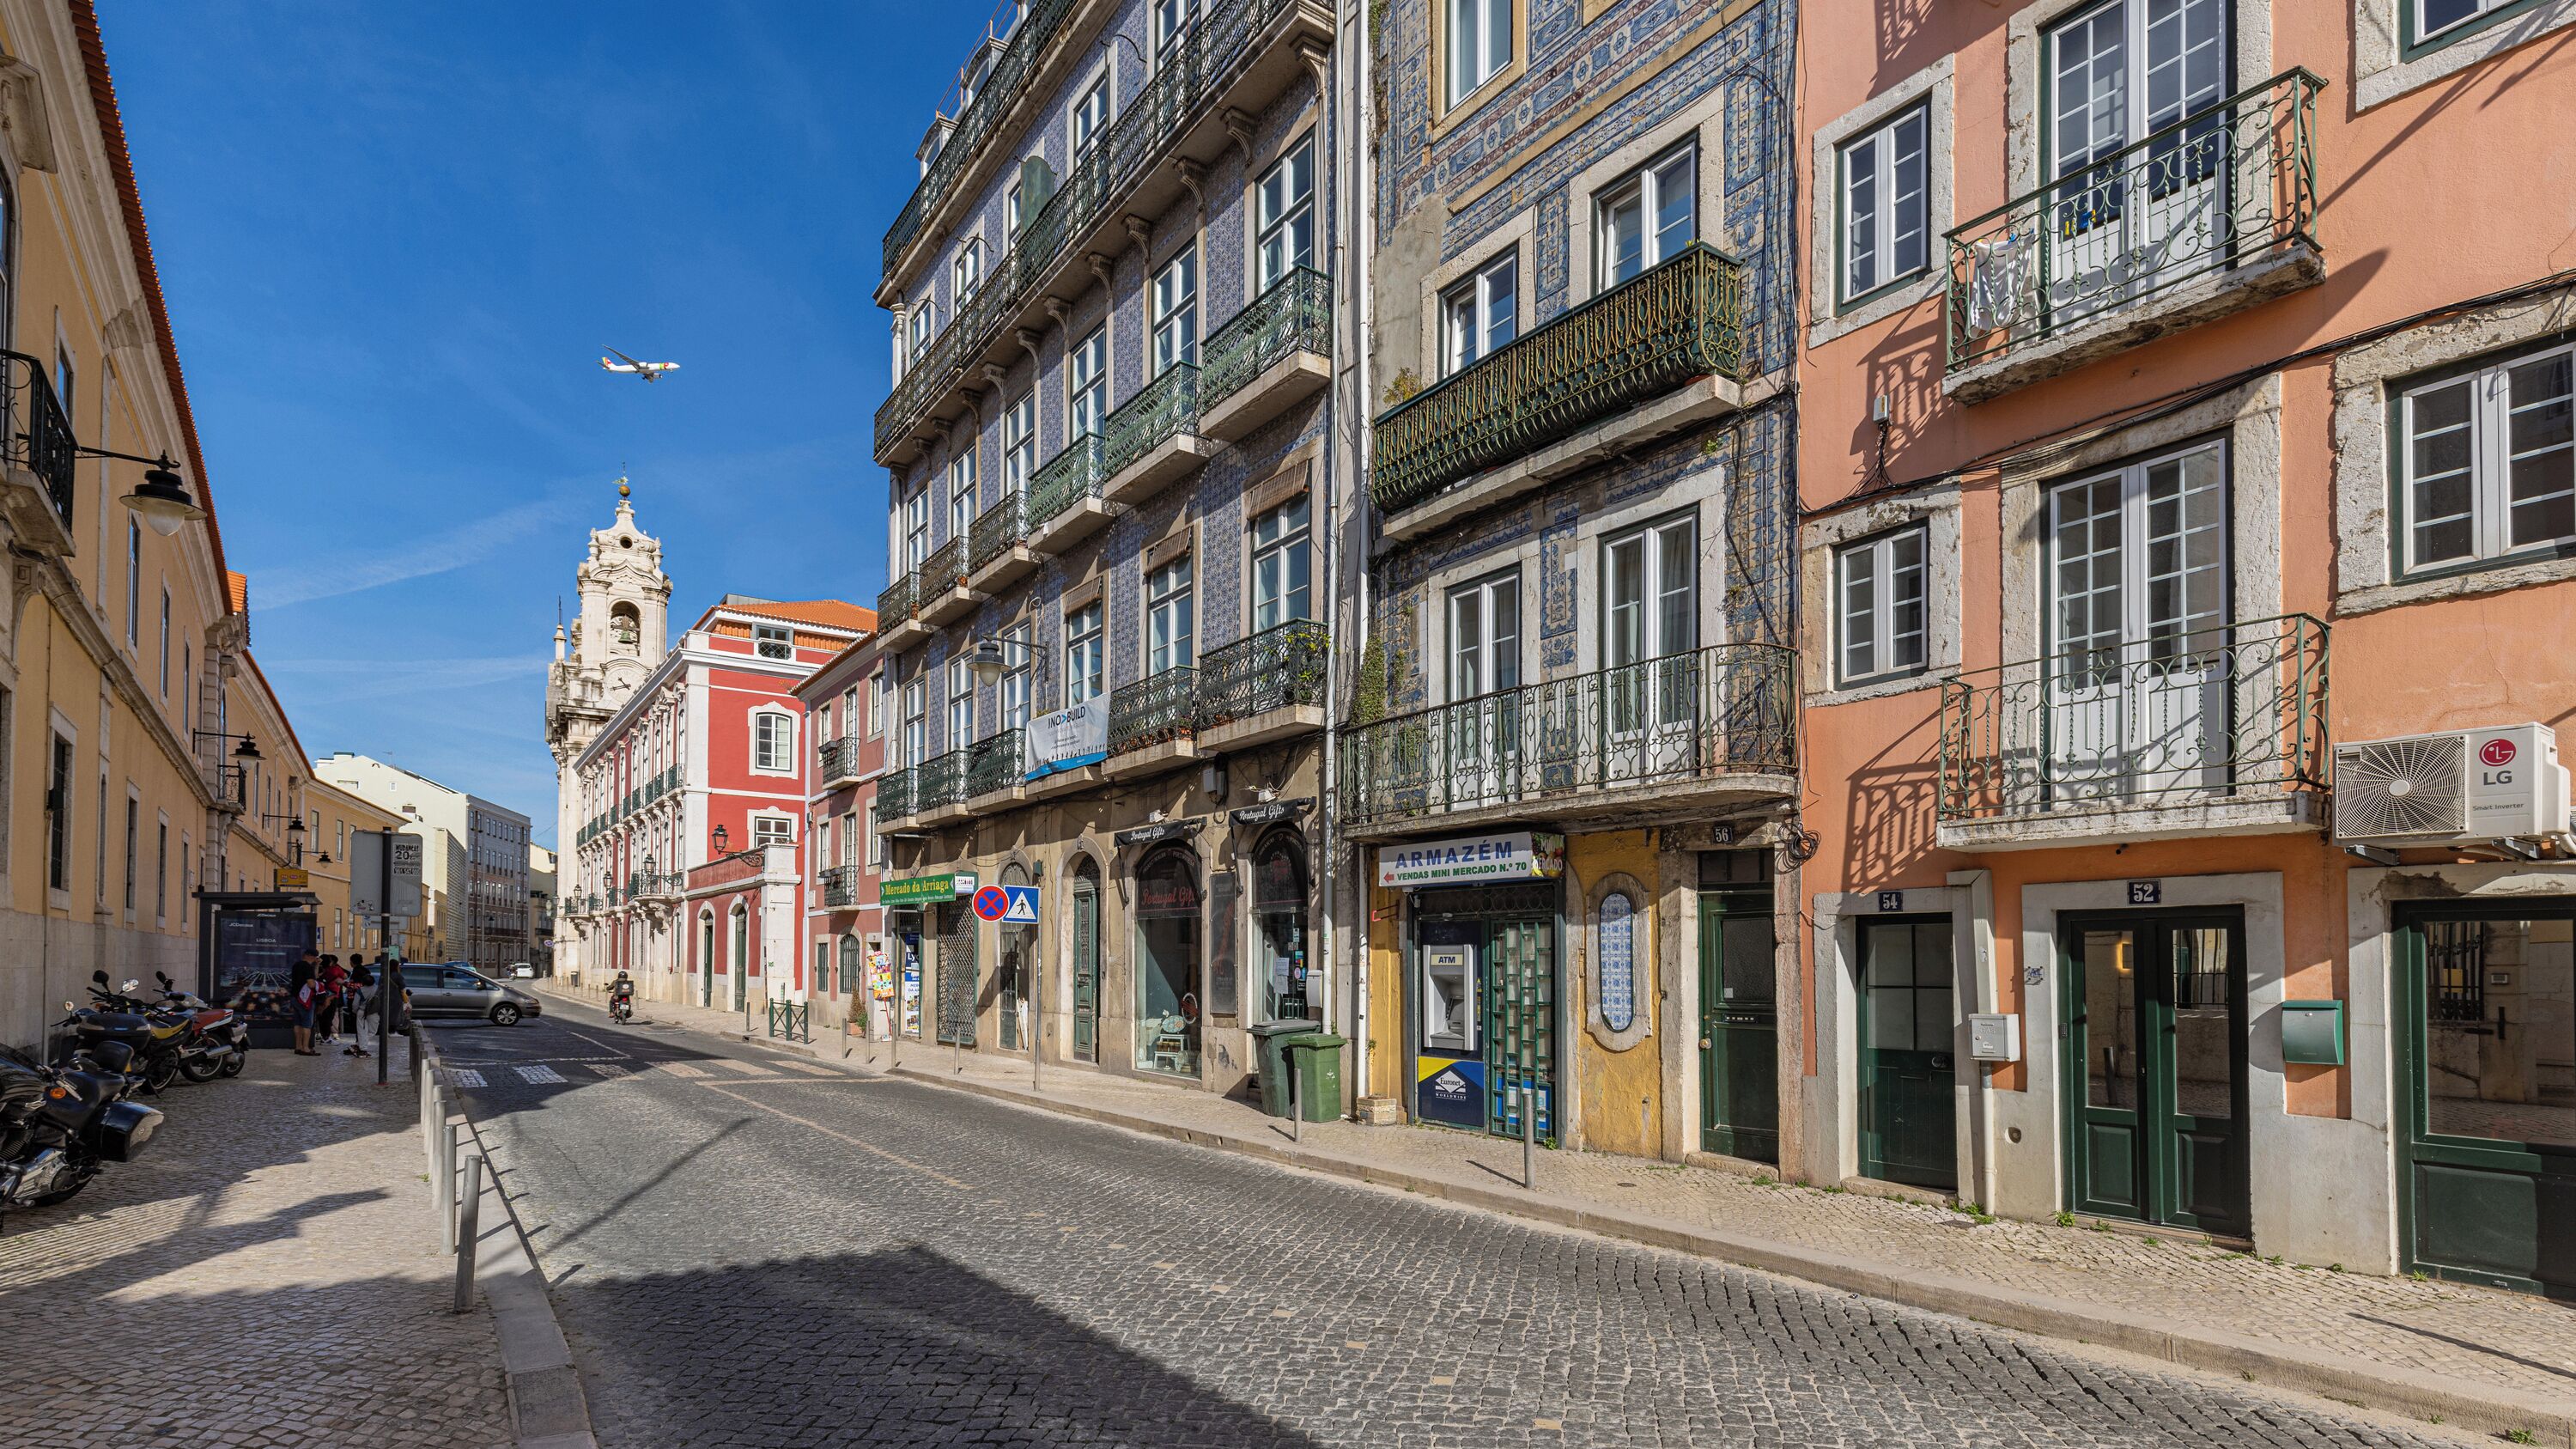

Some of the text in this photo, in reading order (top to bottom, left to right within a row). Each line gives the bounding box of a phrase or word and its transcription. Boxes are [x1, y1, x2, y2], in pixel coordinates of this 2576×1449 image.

[2483, 770, 2512, 785] LG
[1239, 804, 1285, 821] Portugal Gifts
[1131, 825, 1165, 841] Portugal Gifts
[1716, 827, 1728, 842] 56
[1395, 840, 1512, 868] ARMAZÉM
[1397, 871, 1429, 880] VENDAS
[1431, 868, 1450, 877] MINI
[1453, 865, 1497, 876] MERCADO
[1516, 861, 1527, 871] 70
[885, 883, 910, 895] Mercado
[912, 881, 920, 892] da
[922, 879, 949, 893] Arriaga
[2134, 883, 2154, 902] 52
[1883, 893, 1898, 909] 54
[1440, 1078, 1461, 1087] Euronet
